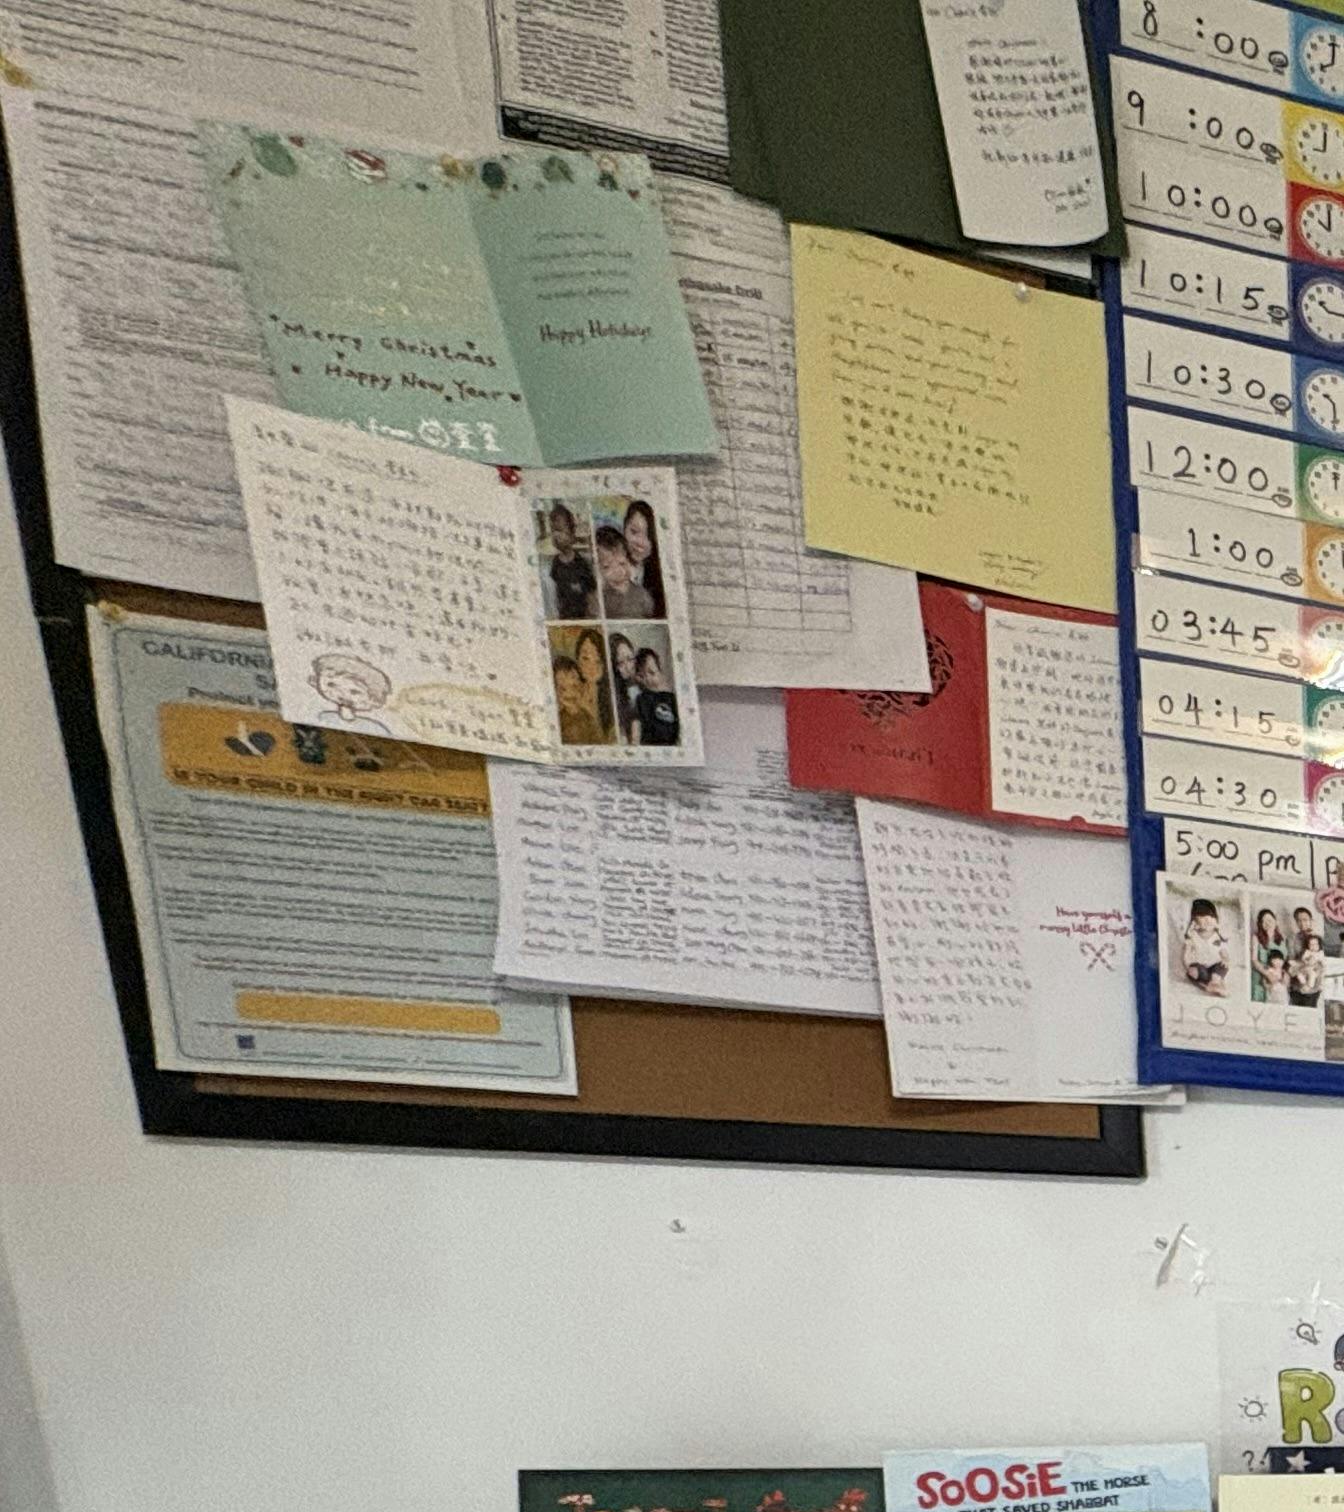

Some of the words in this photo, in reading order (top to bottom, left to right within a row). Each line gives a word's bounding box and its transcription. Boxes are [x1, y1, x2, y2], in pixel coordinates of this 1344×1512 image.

[1152, 610, 1276, 653] 03:45
[1159, 693, 1275, 735] 04:15
[1161, 775, 1277, 808] 04:30
[1177, 829, 1239, 862] 5:00
[1259, 849, 1301, 881] pm
[1070, 1479, 1101, 1494] THE
[1103, 1473, 1151, 1490] HORSE
[1056, 1494, 1120, 1512] SHABBAT
